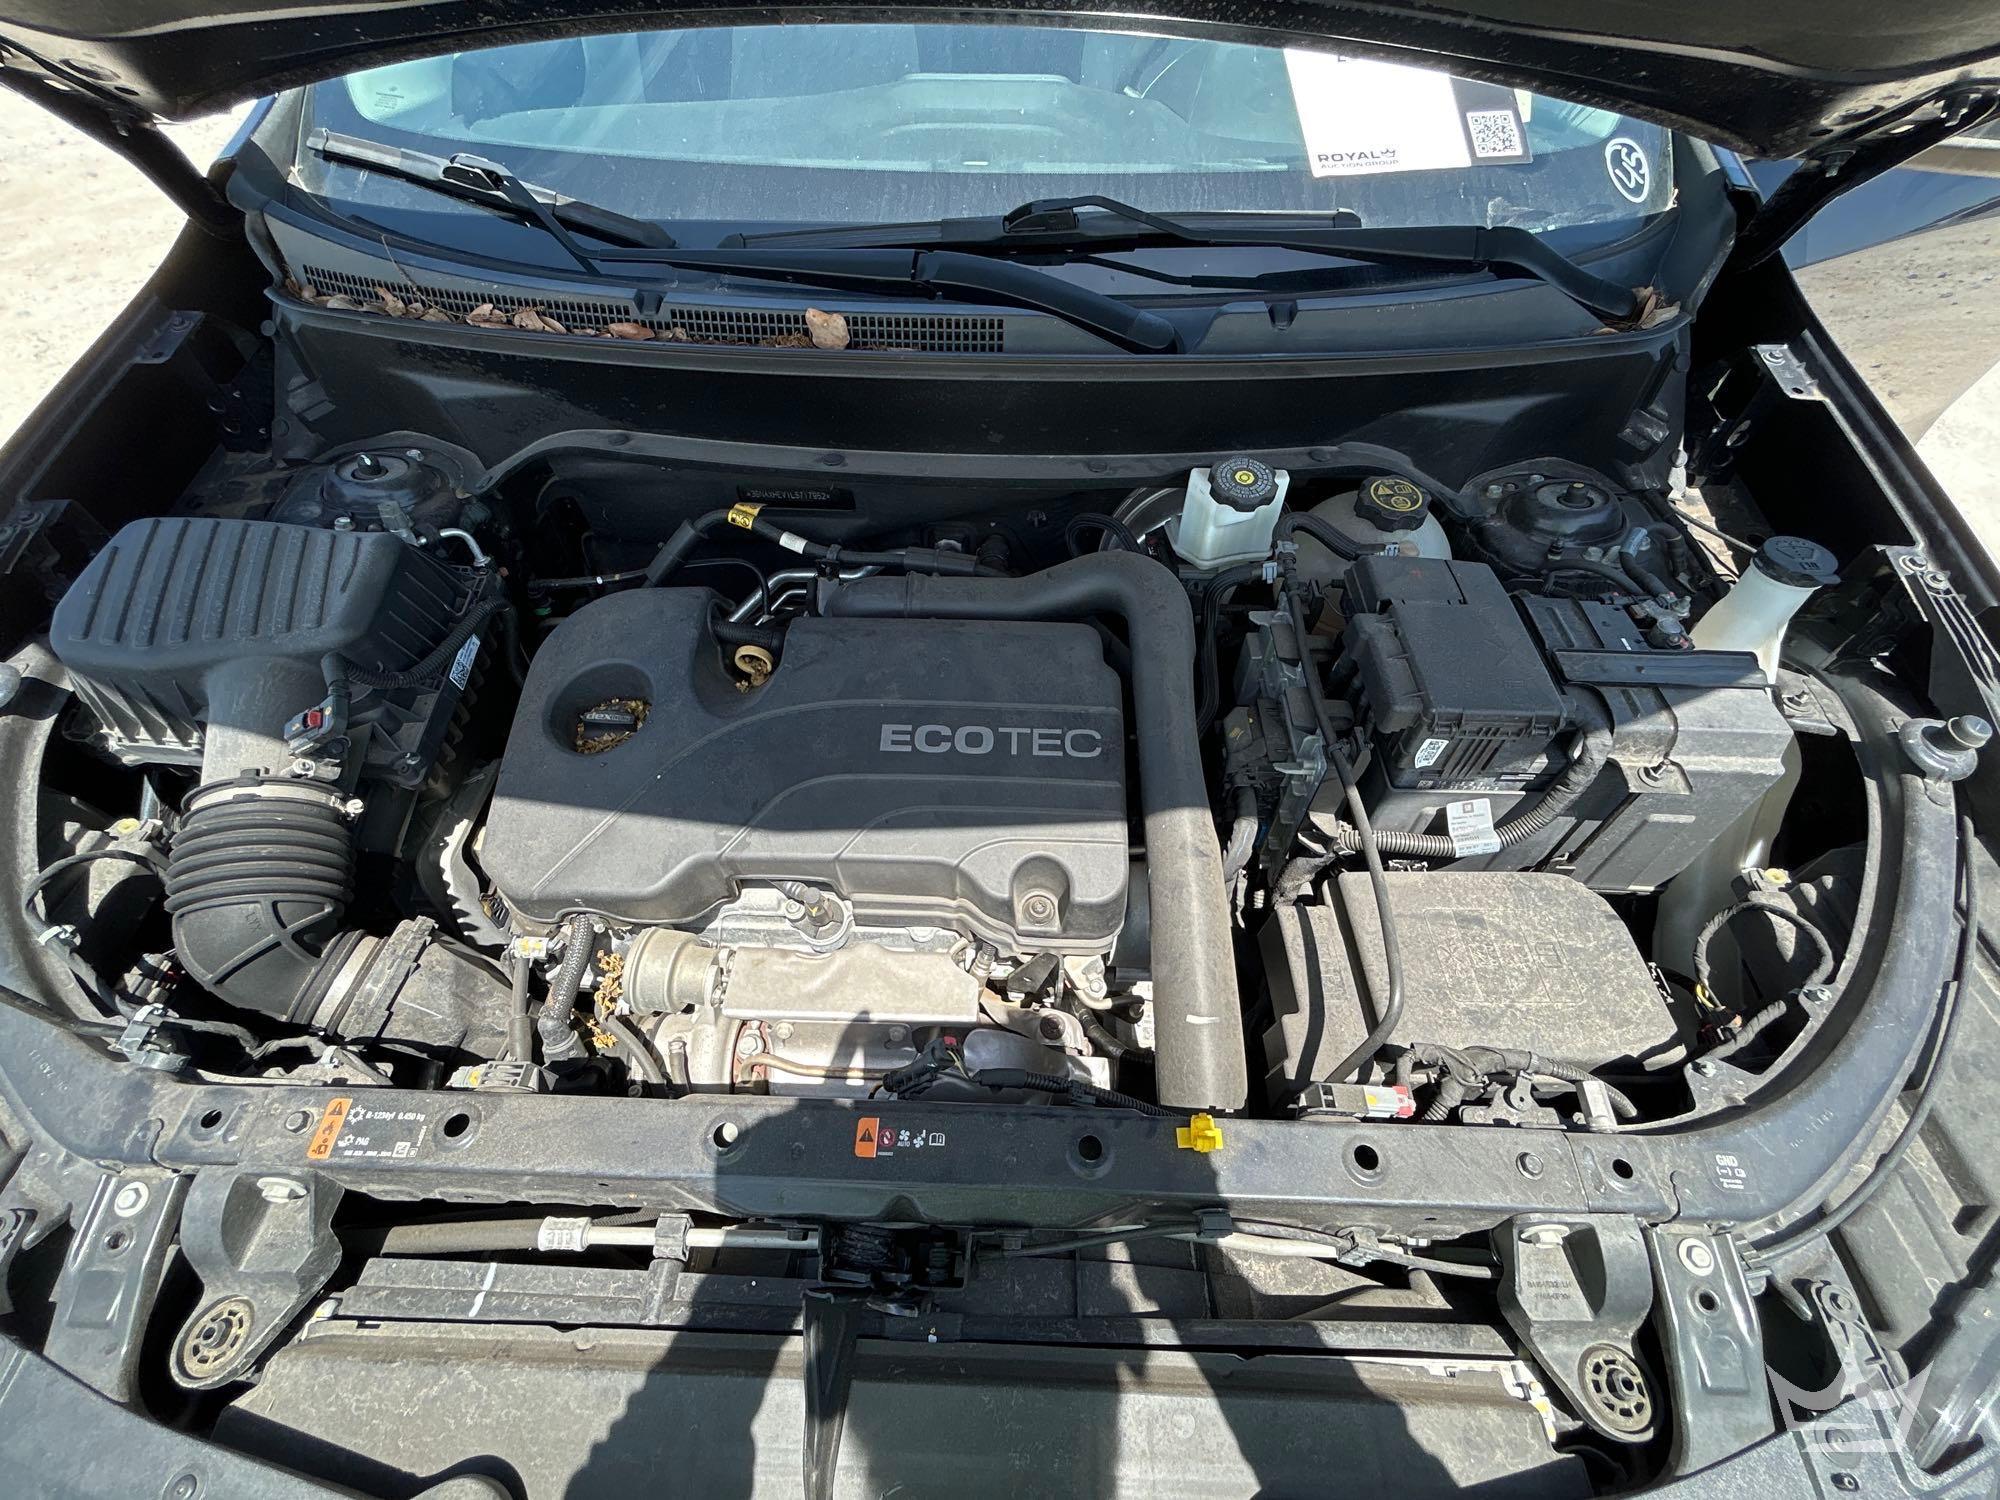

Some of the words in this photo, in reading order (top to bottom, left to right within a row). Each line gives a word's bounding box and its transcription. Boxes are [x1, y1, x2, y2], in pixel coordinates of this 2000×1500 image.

[1317, 150, 1381, 163] ROYAL
[1365, 159, 1399, 167] GROUP
[879, 723, 1102, 758] ECOTEC
[366, 1110, 395, 1121] R-1234yf
[416, 1111, 426, 1122] kg
[355, 1136, 370, 1146] PAG
[1715, 1154, 1738, 1167] GND
